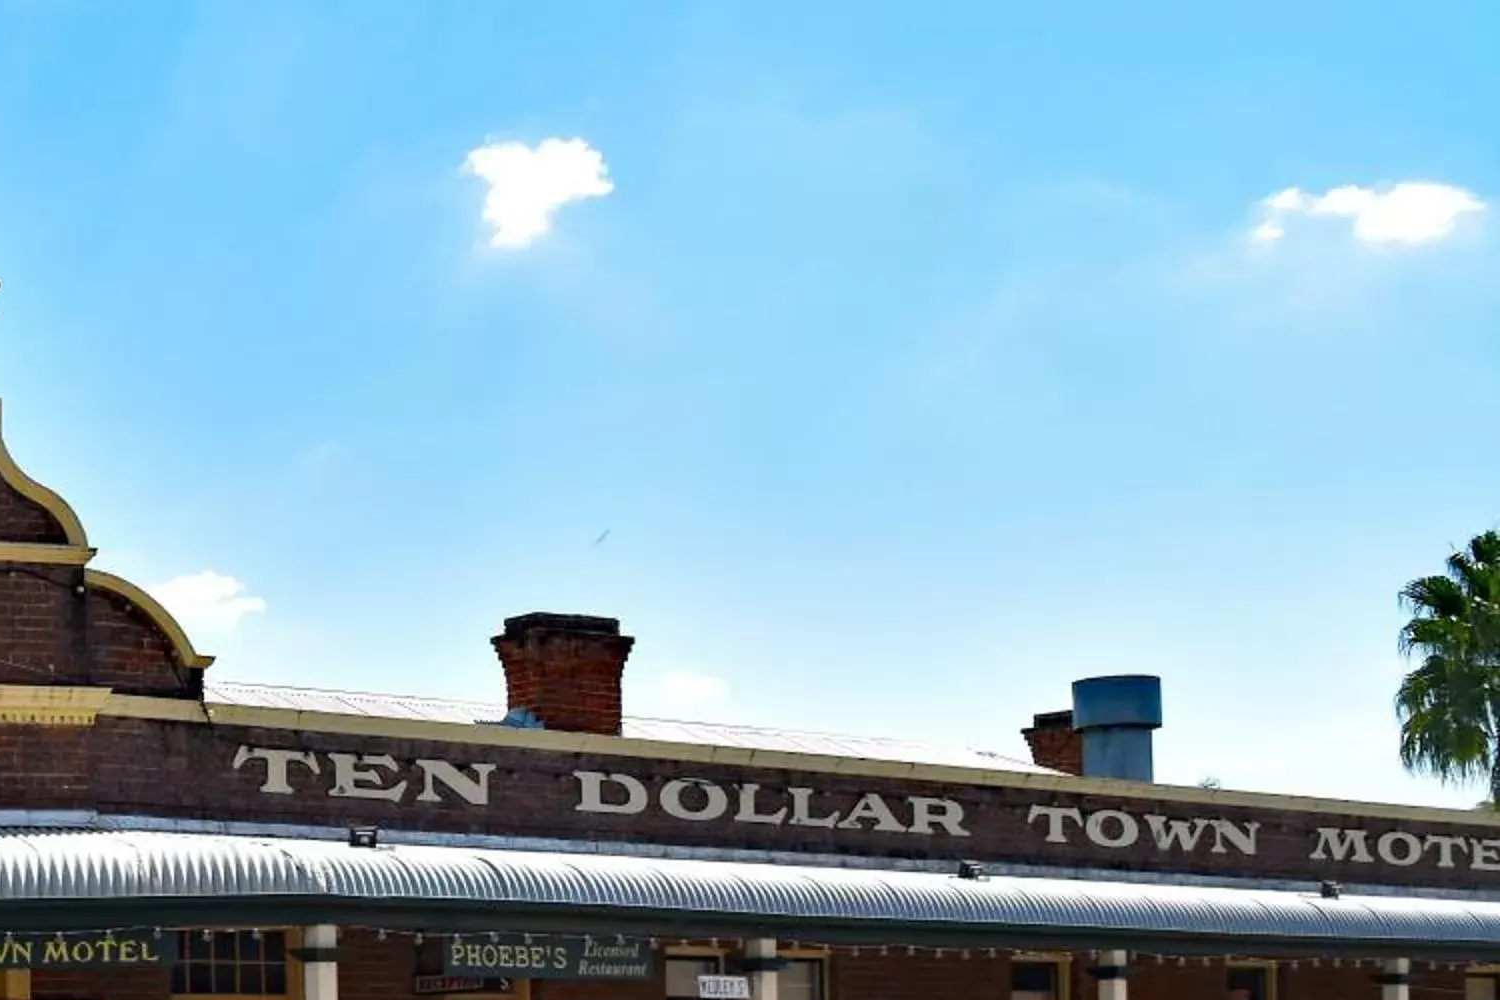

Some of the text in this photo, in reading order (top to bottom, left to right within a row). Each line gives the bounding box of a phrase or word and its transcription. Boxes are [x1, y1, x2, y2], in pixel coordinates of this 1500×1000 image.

[232, 743, 496, 806] TEN
[573, 769, 970, 837] DOLLAR
[1028, 803, 1260, 856] TOWN
[43, 939, 160, 963] MOTEL
[451, 944, 567, 970] PHOEBE'S
[584, 940, 640, 959] Licensed
[578, 960, 648, 977] Restaurant
